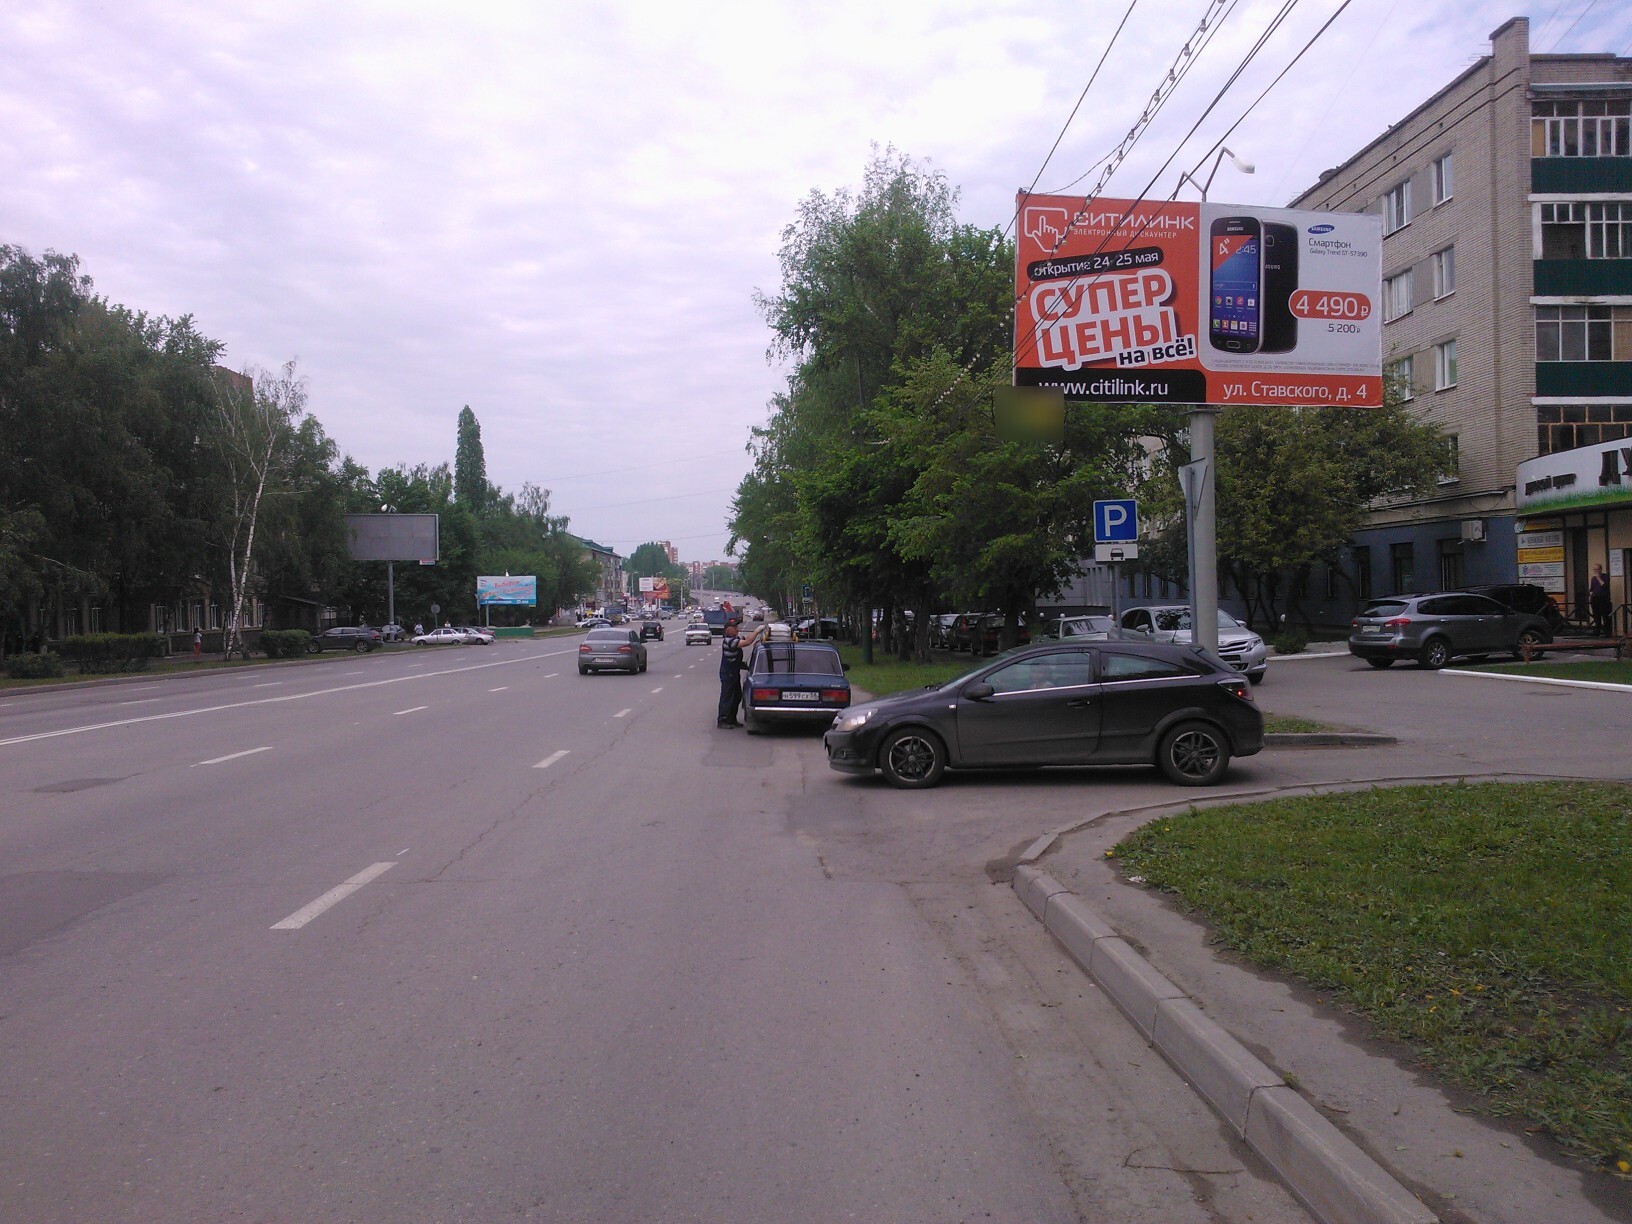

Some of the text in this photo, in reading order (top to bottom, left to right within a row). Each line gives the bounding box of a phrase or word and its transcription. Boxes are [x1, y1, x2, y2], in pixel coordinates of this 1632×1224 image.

[1308, 237, 1352, 249] Смартфон
[1309, 247, 1326, 256] Galaxy
[1033, 260, 1091, 277] открытие
[1135, 251, 1159, 264] мая
[1035, 274, 1167, 322] СУПЕР
[1041, 311, 1172, 366] ЦЕНЫ
[1119, 337, 1194, 366] на всё!
[1223, 380, 1367, 402] ул. Ставского, д. 4
[1103, 504, 1128, 537] P
